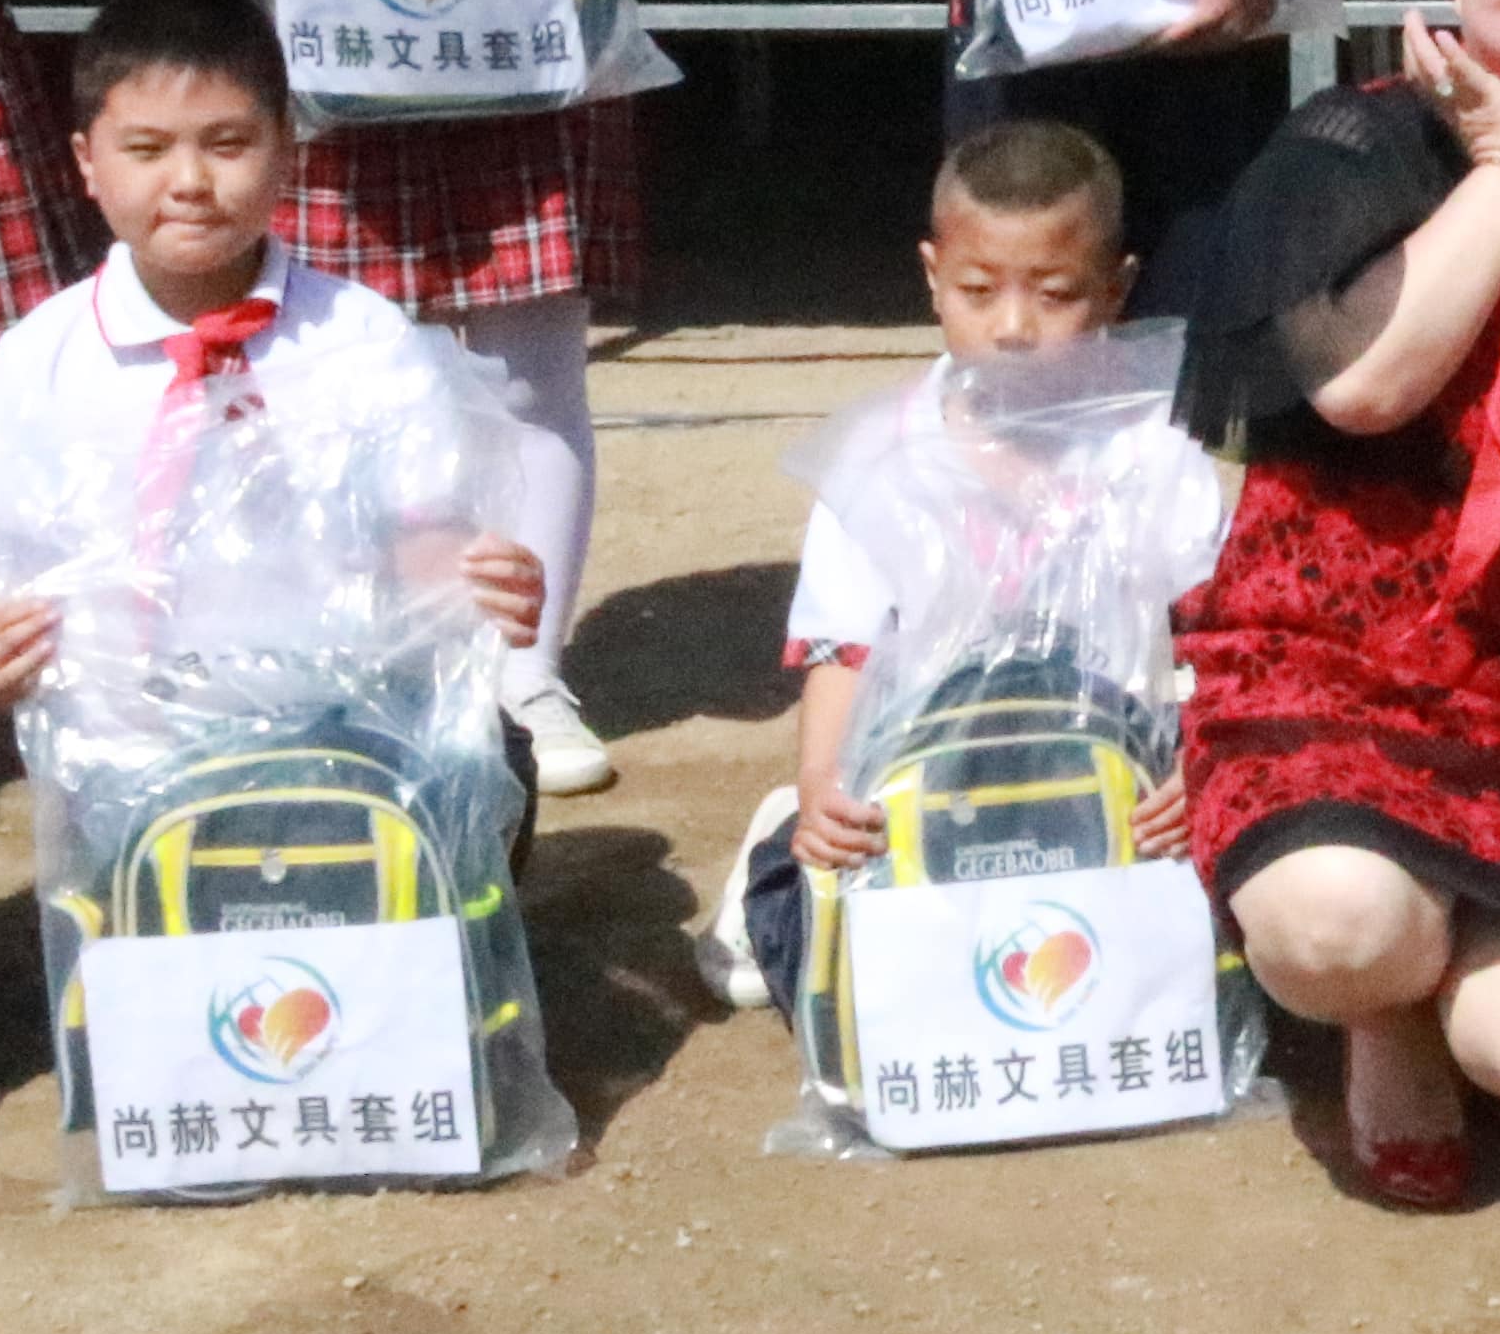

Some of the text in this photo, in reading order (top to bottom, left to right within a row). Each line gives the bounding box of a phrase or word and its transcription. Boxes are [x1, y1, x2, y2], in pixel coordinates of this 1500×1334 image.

[290, 19, 573, 71] 尚赫文具套组
[876, 1027, 1210, 1116] 尚赫文具套组
[112, 1089, 463, 1160] 尚赫文具套组
